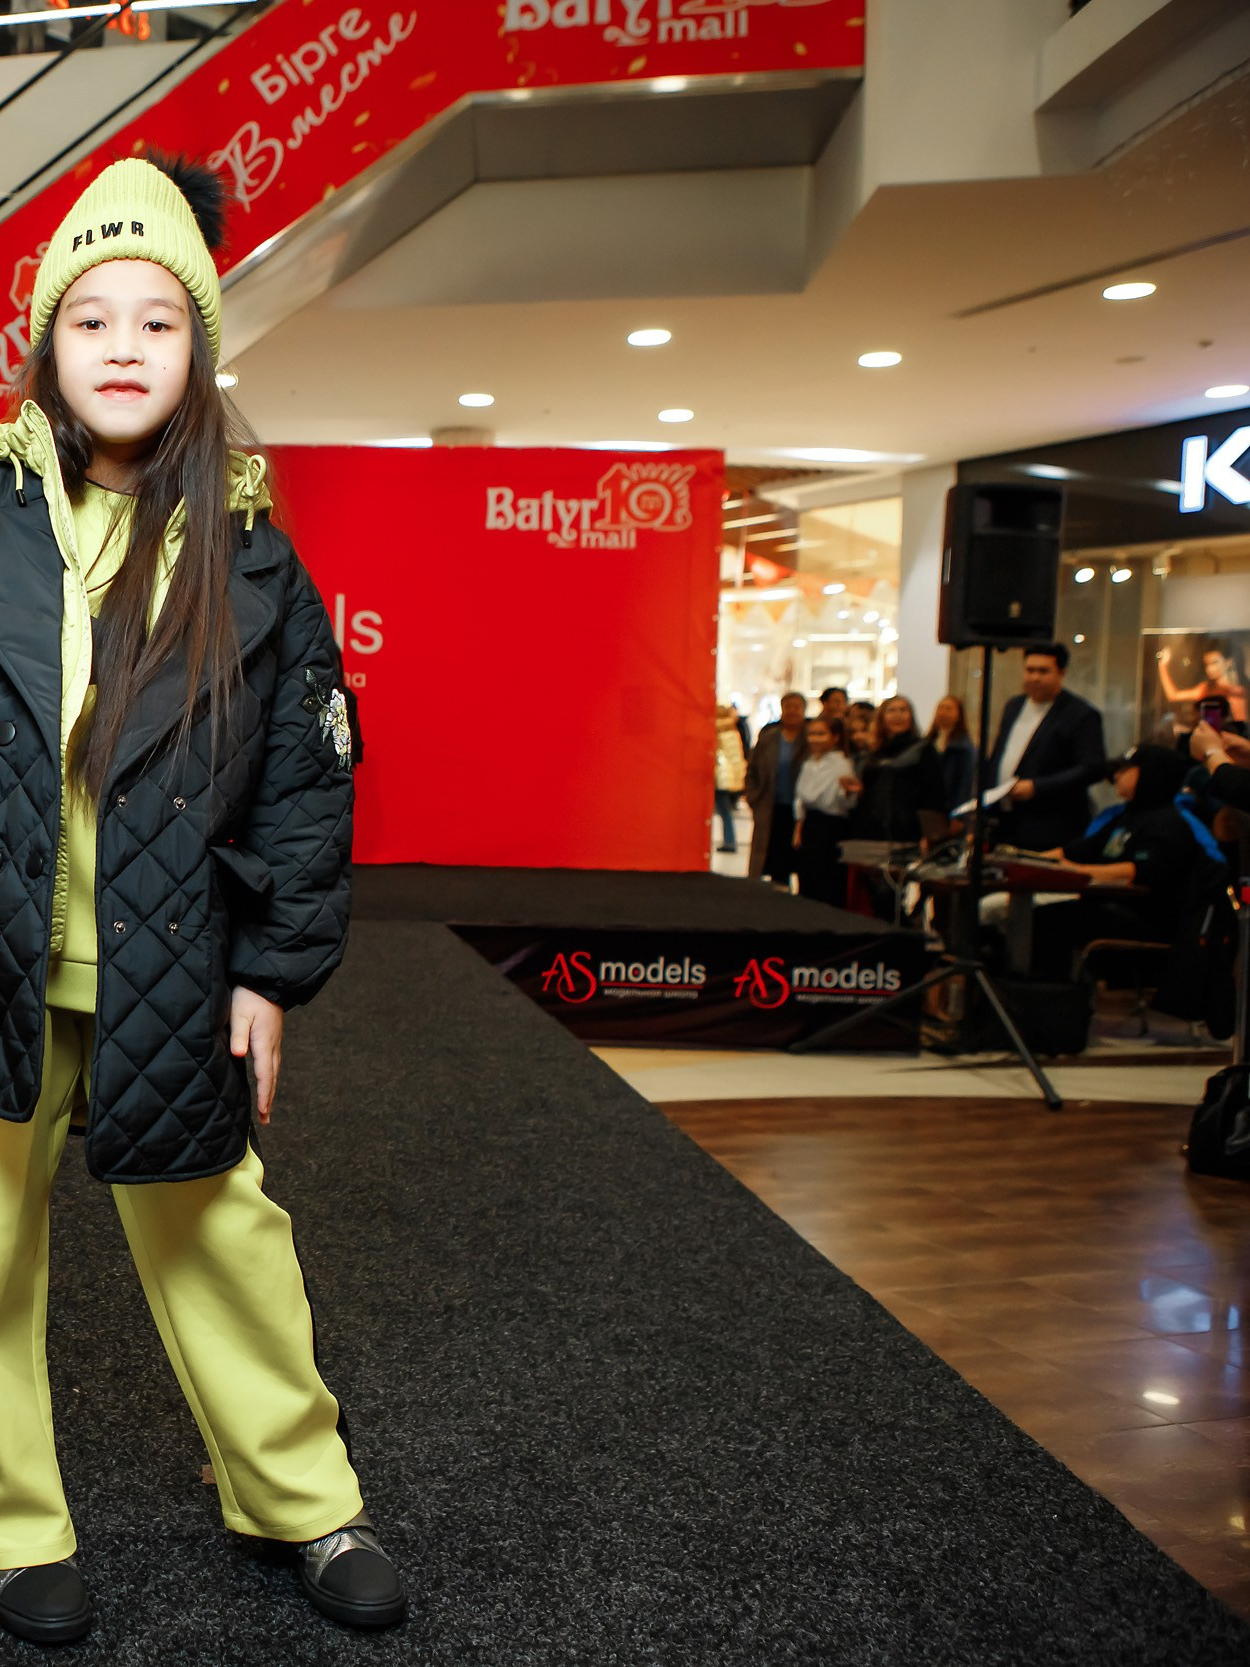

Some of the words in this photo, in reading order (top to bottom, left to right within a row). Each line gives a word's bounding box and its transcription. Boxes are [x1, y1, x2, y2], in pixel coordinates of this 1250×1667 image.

[658, 9, 748, 43] mall
[251, 8, 372, 105] Бірге
[485, 486, 599, 548] Batyr
[580, 528, 637, 549] mall
[541, 951, 597, 1003] AS
[600, 956, 707, 985] models
[733, 957, 790, 1009] AS
[792, 960, 901, 991] models
